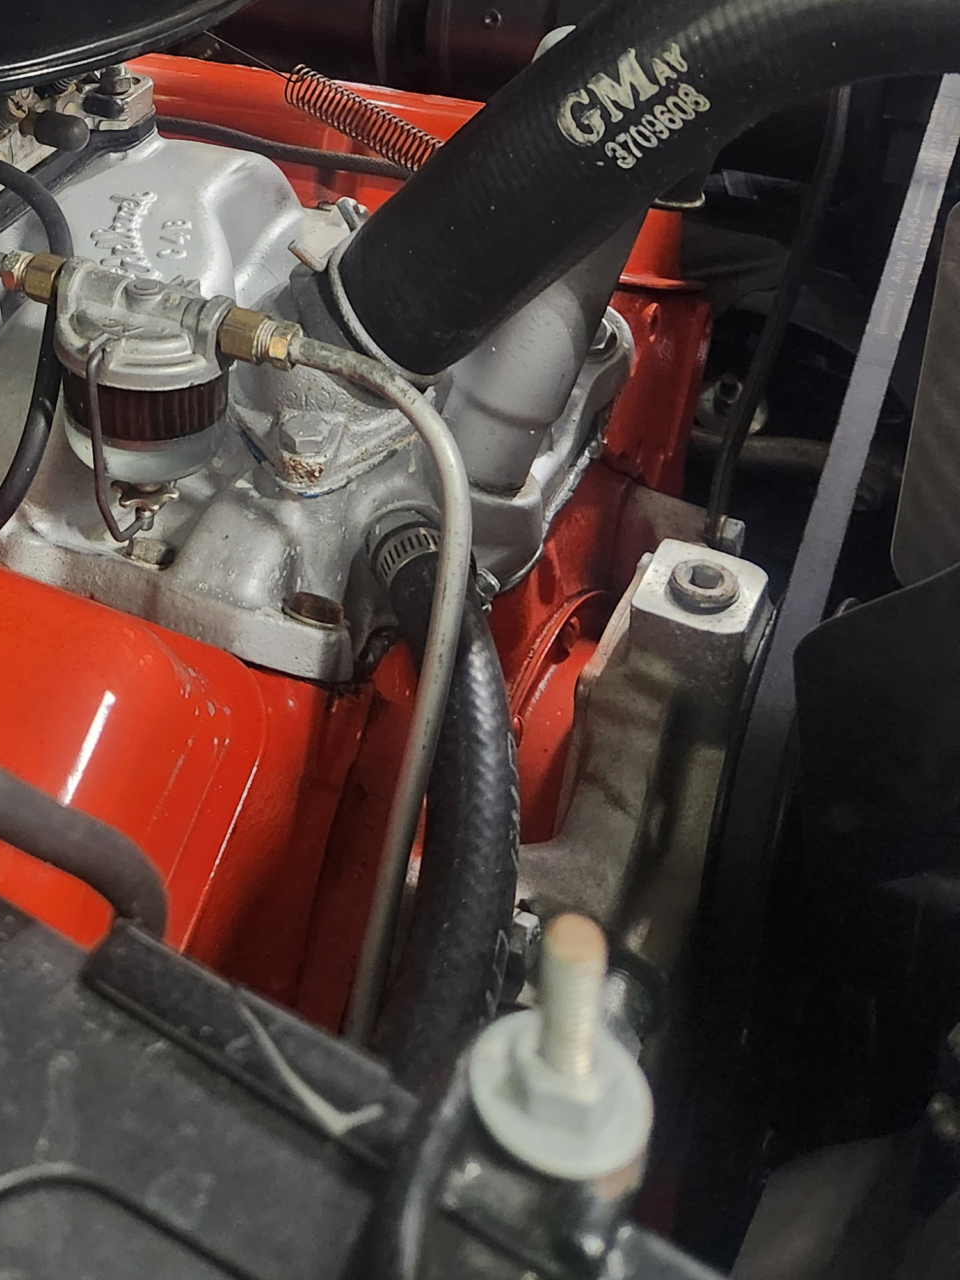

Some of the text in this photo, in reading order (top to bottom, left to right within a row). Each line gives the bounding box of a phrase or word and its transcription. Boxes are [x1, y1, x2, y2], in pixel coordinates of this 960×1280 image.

[557, 48, 660, 147] GM
[605, 83, 711, 169] 3709608
[156, 219, 192, 259] C4B
[901, 217, 921, 245] 15545
